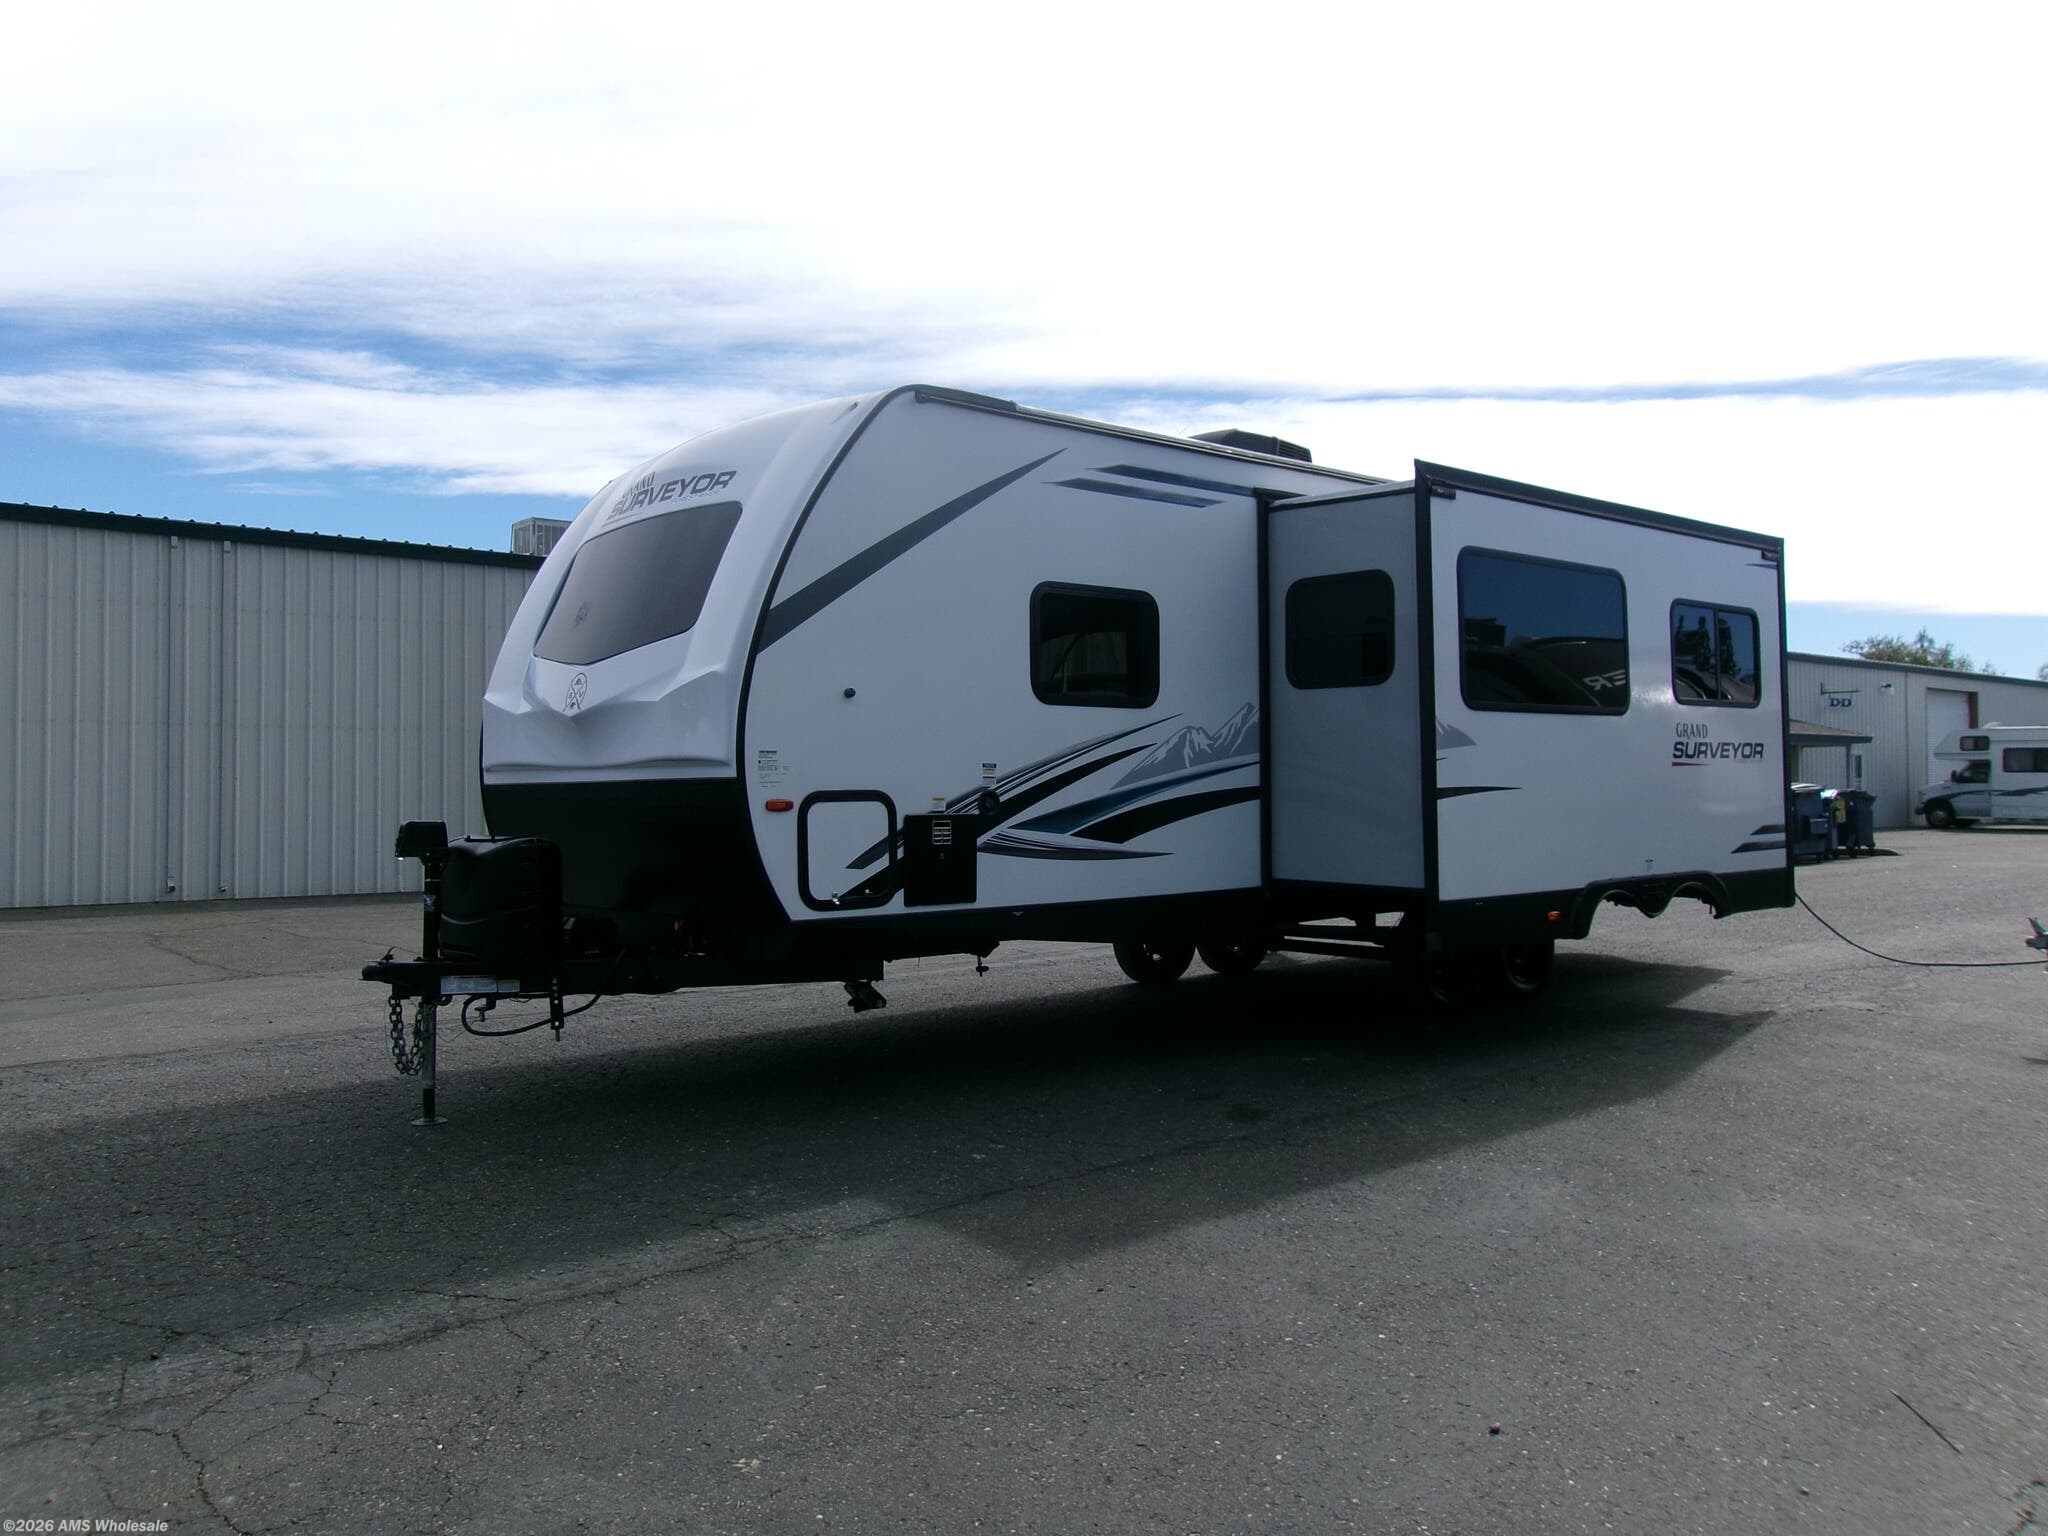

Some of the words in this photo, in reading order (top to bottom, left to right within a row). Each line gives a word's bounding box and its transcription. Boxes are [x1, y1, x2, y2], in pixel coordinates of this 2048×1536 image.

[606, 470, 737, 521] SURVEYOR
[1675, 722, 1708, 739] GRAND
[1672, 741, 1764, 759] SURVEYOR
